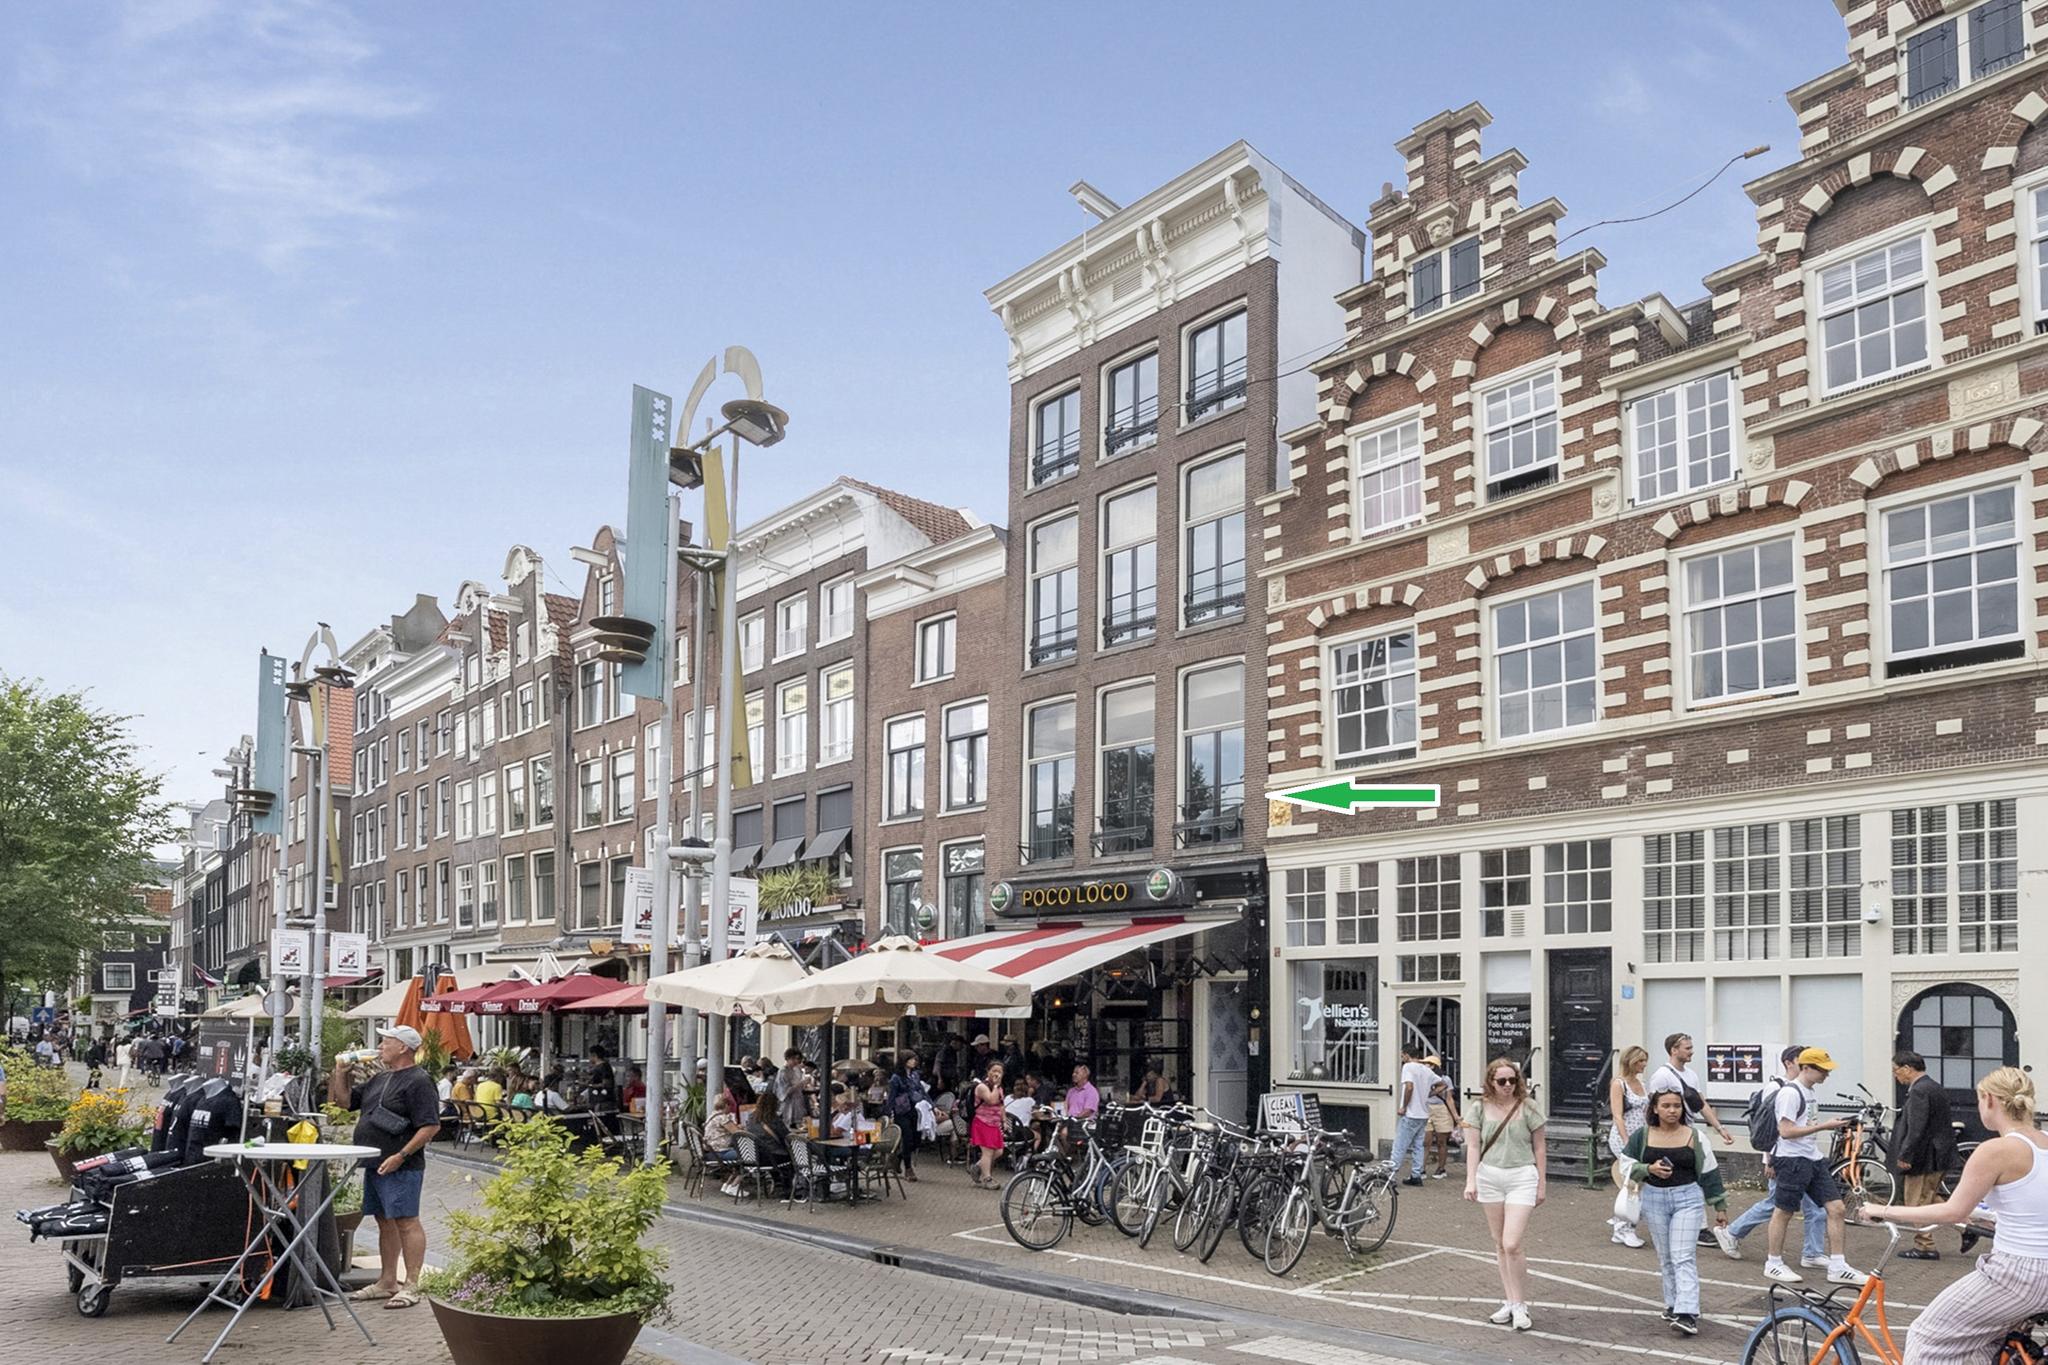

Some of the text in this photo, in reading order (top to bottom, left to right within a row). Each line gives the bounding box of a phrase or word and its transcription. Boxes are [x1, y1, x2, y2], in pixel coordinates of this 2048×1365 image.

[1022, 882, 1128, 907] POCO LOCO
[518, 998, 539, 1011] Drinks
[1488, 1013, 1500, 1021] Gel
[1334, 1018, 1378, 1028] Nailstudio
[1488, 1021, 1531, 1030] Foot massag
[1488, 1029, 1501, 1037] Eye
[1488, 1037, 1513, 1045] Waxing
[1271, 1097, 1296, 1111] CLEAN
